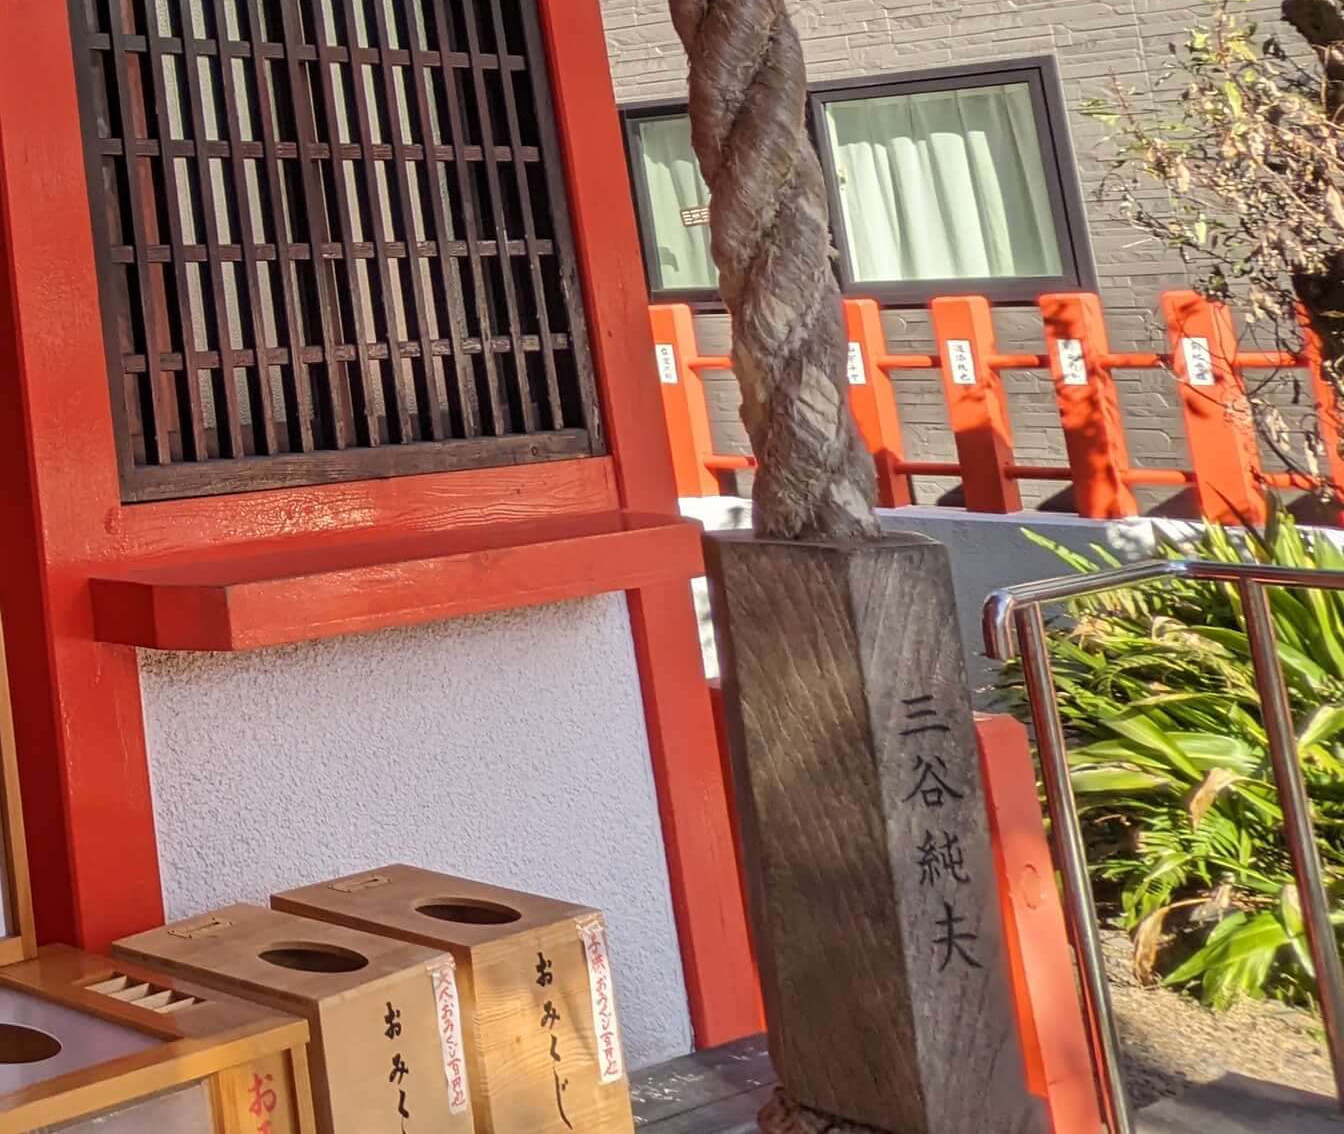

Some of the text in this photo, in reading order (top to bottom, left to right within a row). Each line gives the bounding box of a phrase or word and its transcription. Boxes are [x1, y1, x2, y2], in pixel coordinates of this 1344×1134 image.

[898, 694, 983, 972] 三谷純夫
[247, 1072, 278, 1134] お
[383, 1000, 410, 1134] おみく
[534, 952, 573, 1131] おみくじ
